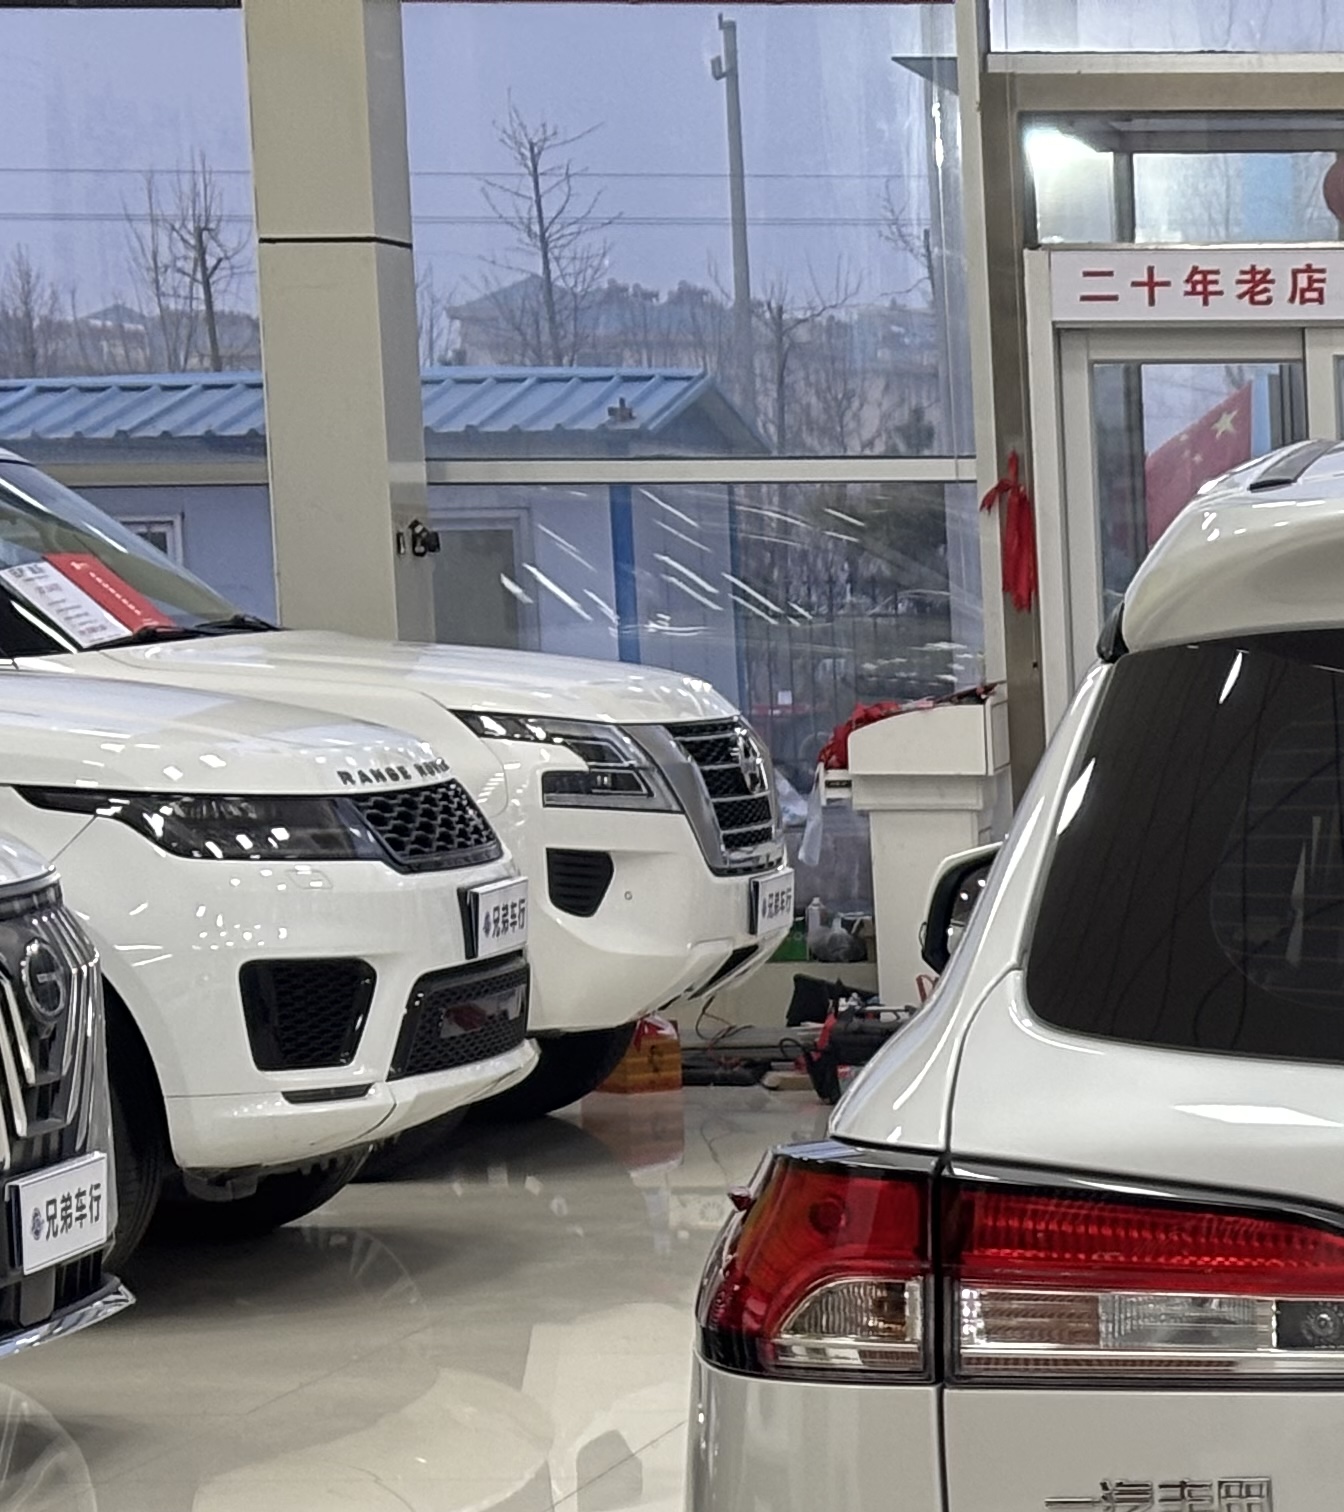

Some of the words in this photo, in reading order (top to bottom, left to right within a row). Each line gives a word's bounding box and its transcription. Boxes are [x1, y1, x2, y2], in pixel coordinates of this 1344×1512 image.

[1078, 262, 1328, 307] 二十年老店
[337, 766, 412, 785] RANGE
[492, 898, 526, 938] 兄弟车行
[45, 1182, 103, 1241] 兄弟车行
